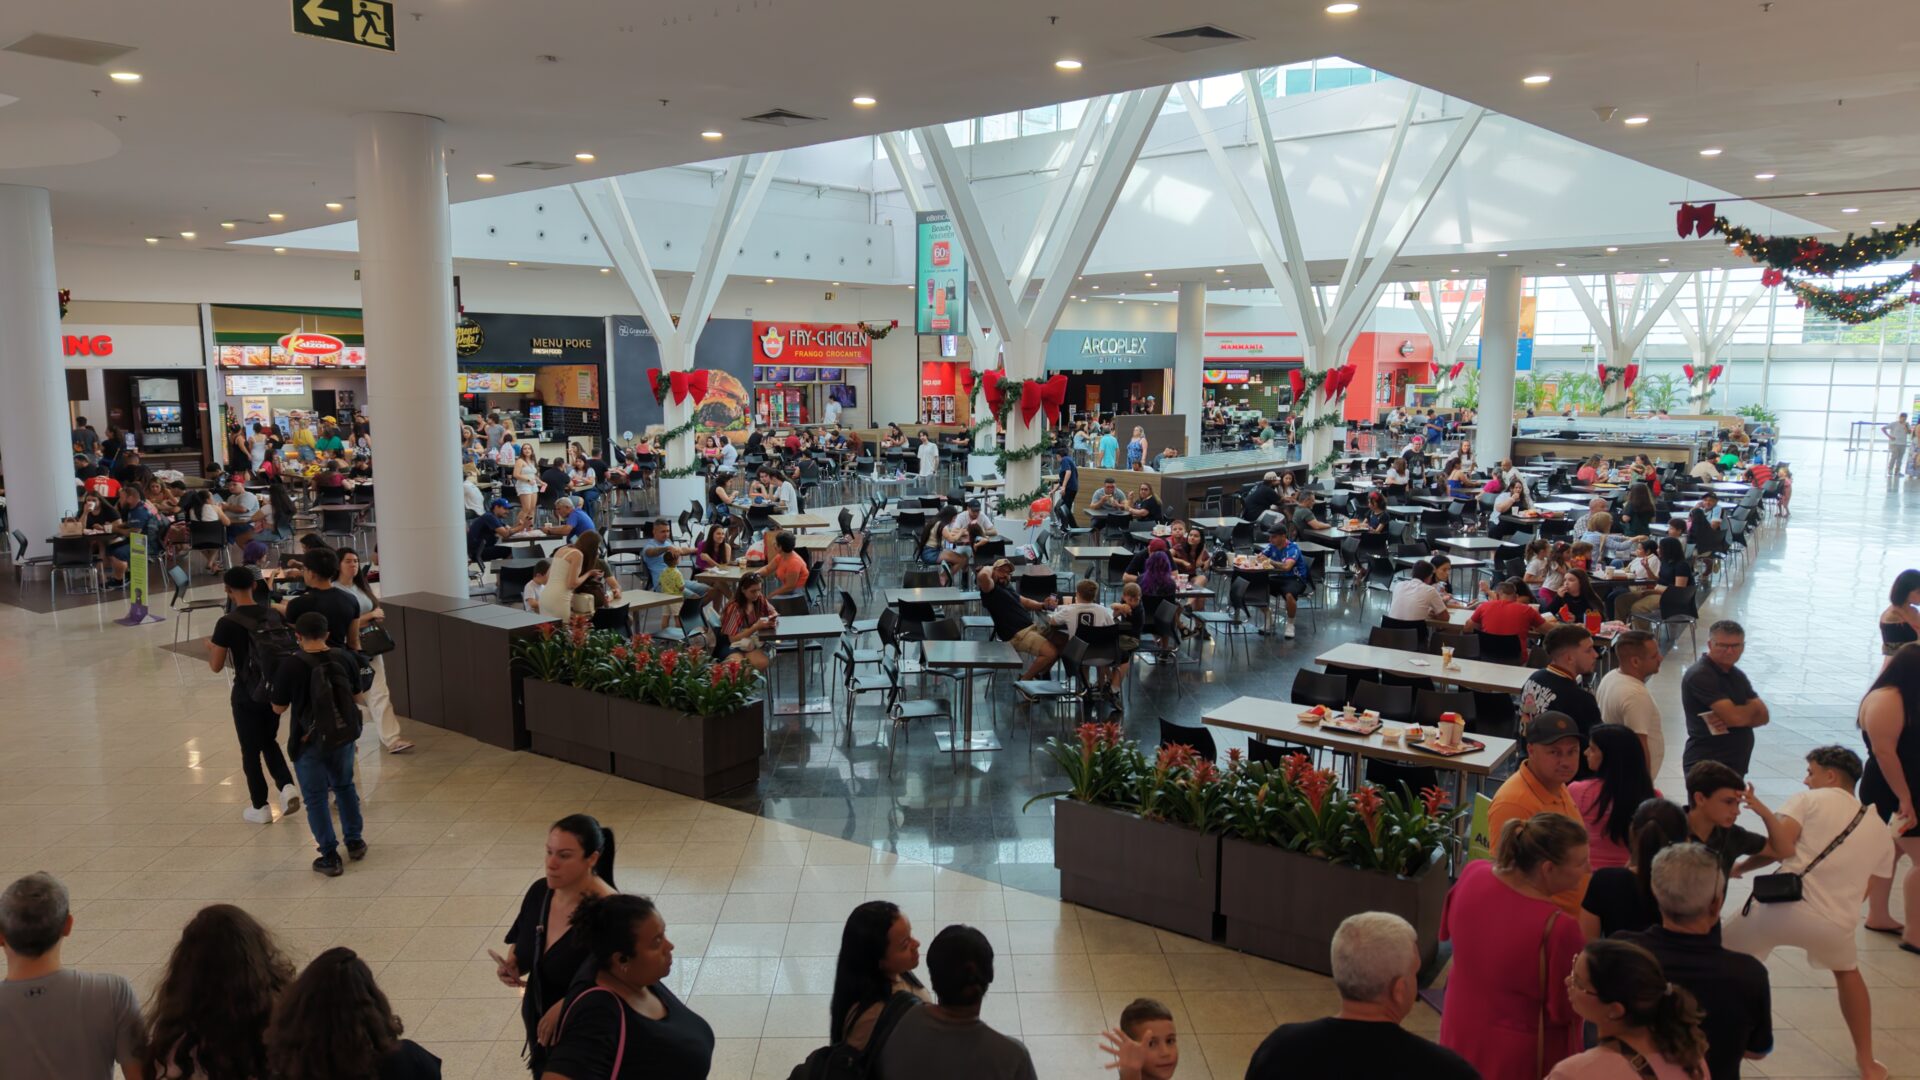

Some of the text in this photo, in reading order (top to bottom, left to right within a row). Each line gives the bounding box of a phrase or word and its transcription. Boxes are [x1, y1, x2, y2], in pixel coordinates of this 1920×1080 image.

[533, 338, 592, 349] MENU POKE
[789, 330, 867, 346] FRY-CHICKEN
[1081, 336, 1147, 354] ARCOPLEX
